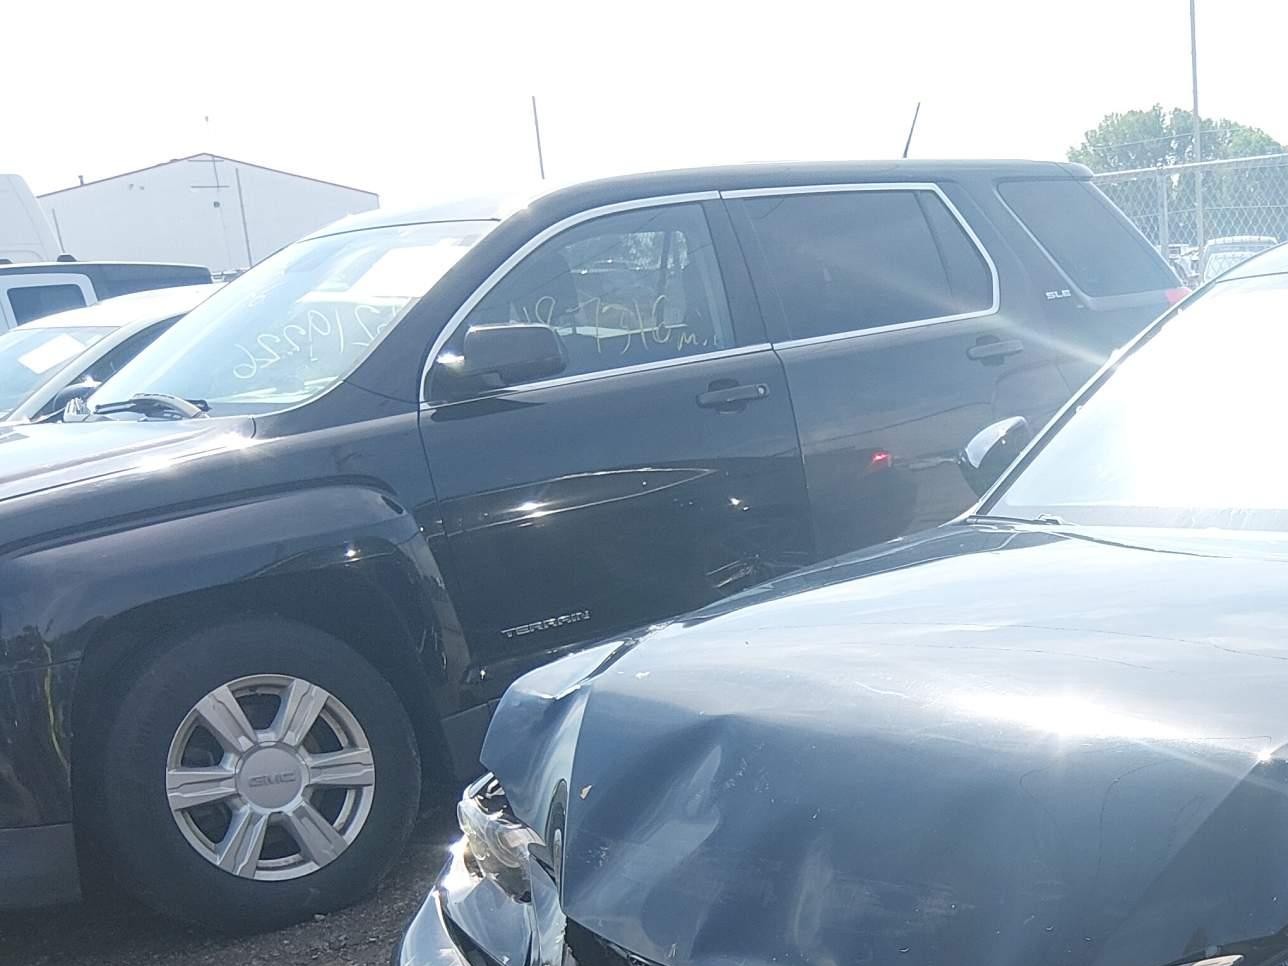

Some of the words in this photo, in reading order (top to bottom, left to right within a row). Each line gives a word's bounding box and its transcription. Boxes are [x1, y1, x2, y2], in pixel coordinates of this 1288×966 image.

[1045, 289, 1072, 300] SLE
[500, 610, 591, 638] TERRAIN
[247, 772, 296, 788] GMC
